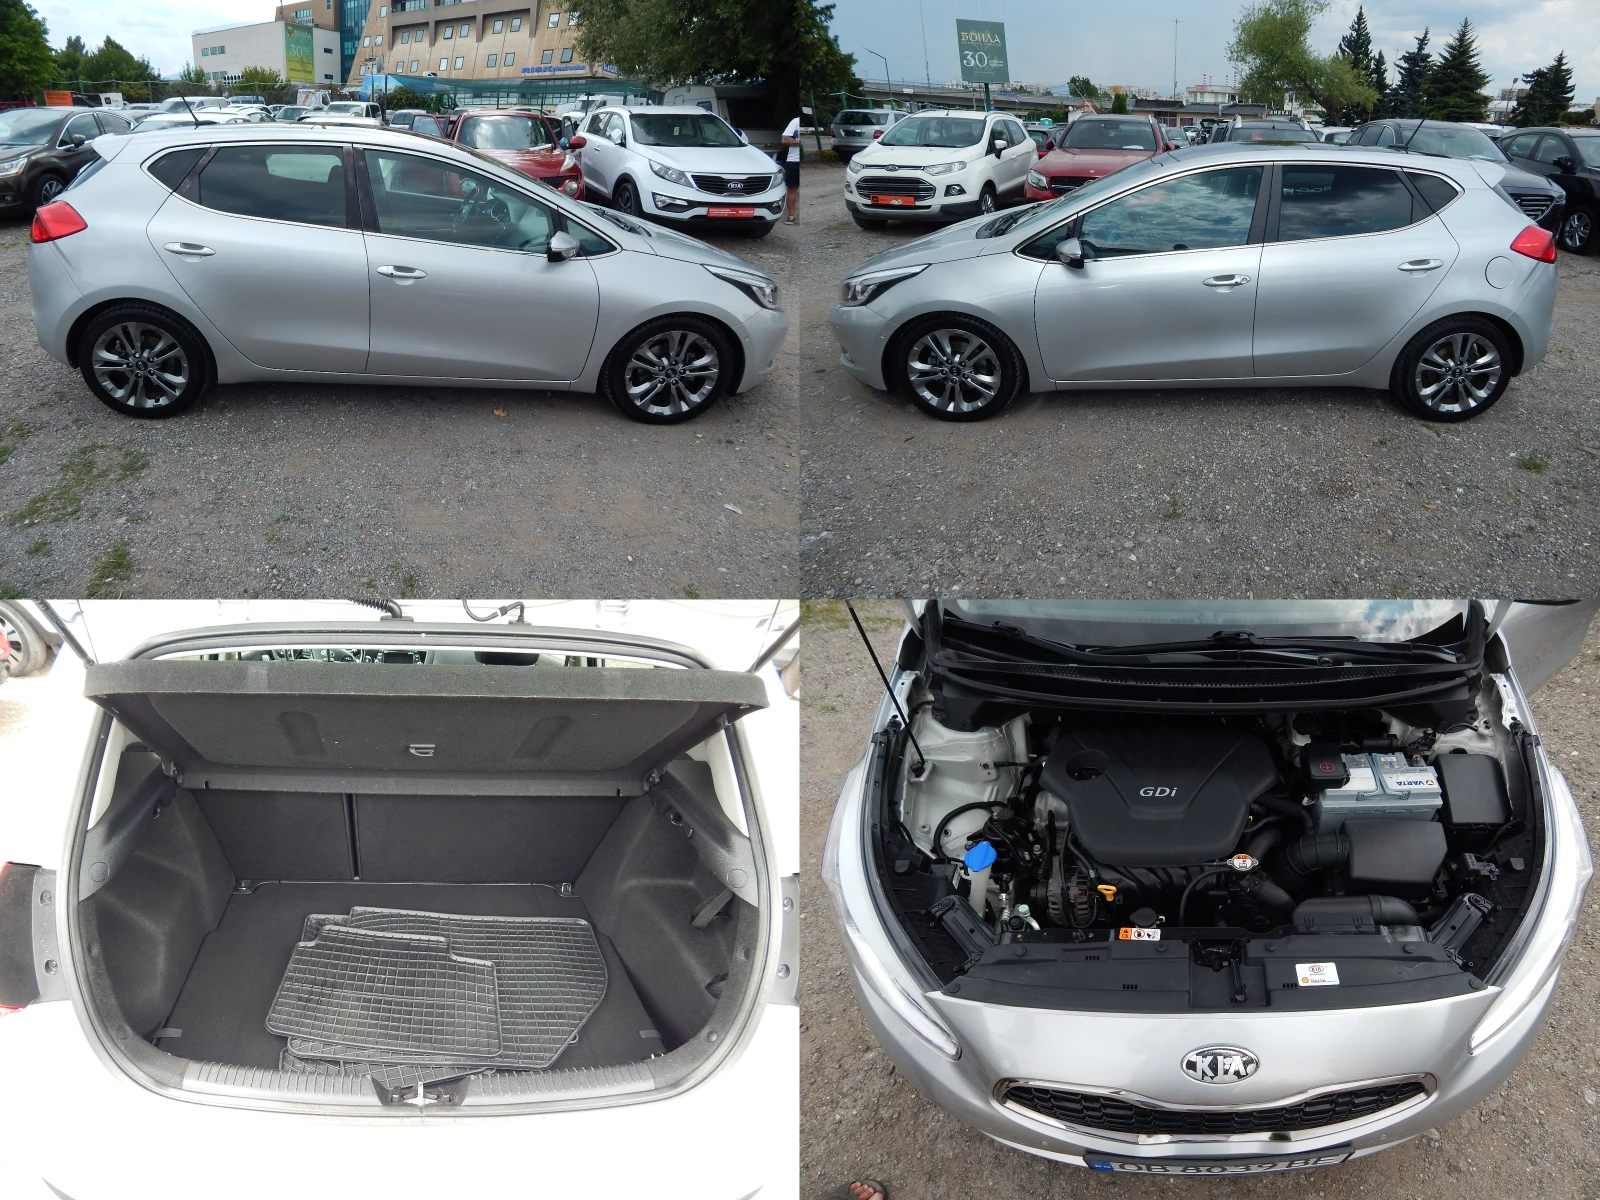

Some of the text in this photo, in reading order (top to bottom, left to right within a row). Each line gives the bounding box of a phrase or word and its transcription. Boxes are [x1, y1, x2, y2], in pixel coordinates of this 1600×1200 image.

[290, 44, 303, 57] 30
[963, 50, 988, 67] 30
[1139, 786, 1178, 797] GDi
[1195, 1055, 1247, 1077] KIA
